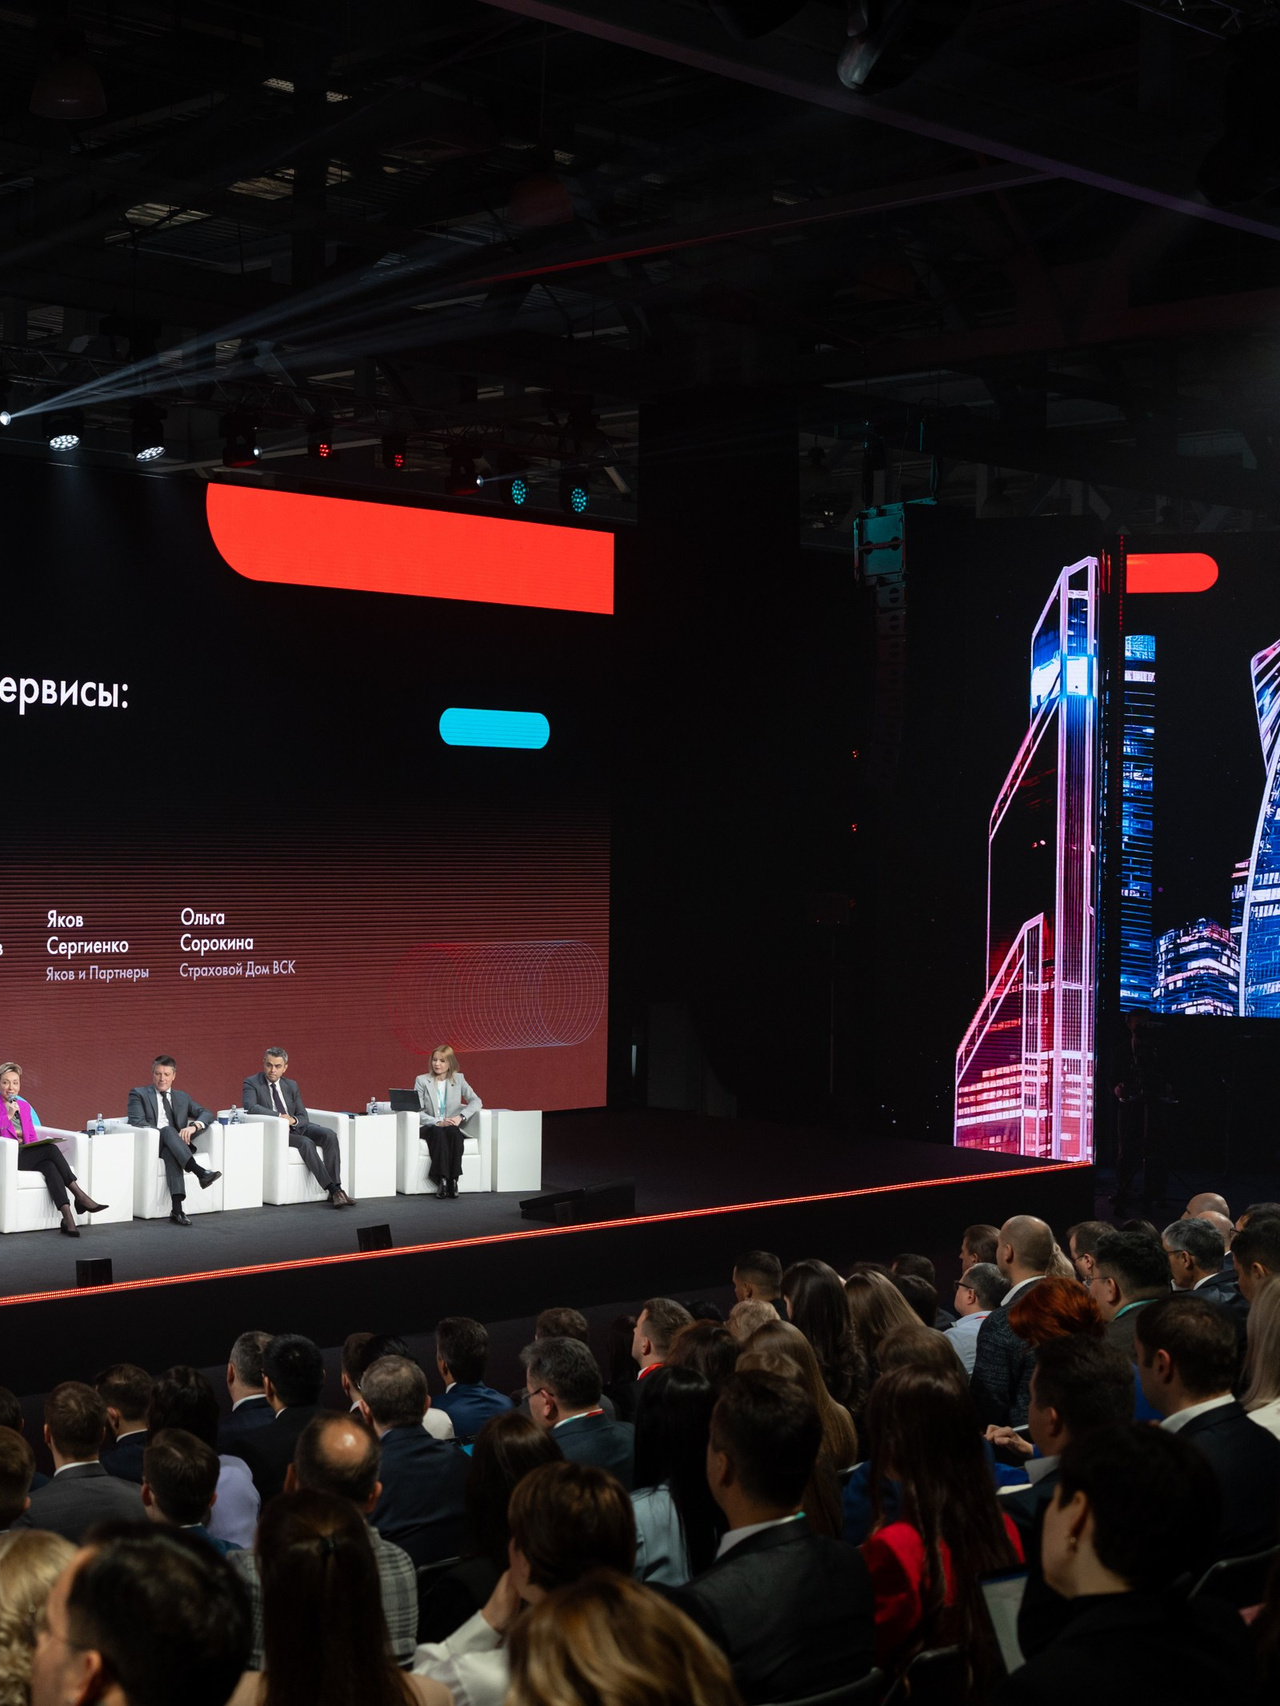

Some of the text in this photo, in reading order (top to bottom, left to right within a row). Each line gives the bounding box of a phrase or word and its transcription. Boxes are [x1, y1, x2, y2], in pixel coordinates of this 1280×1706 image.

[46, 909, 84, 928] Яков
[180, 907, 225, 926] Ольга
[46, 936, 129, 960] Сергиенко
[180, 933, 254, 956] Сорокина
[46, 965, 149, 984] Яков и Партнеры
[179, 959, 296, 981] Страховой Дом ВСК
